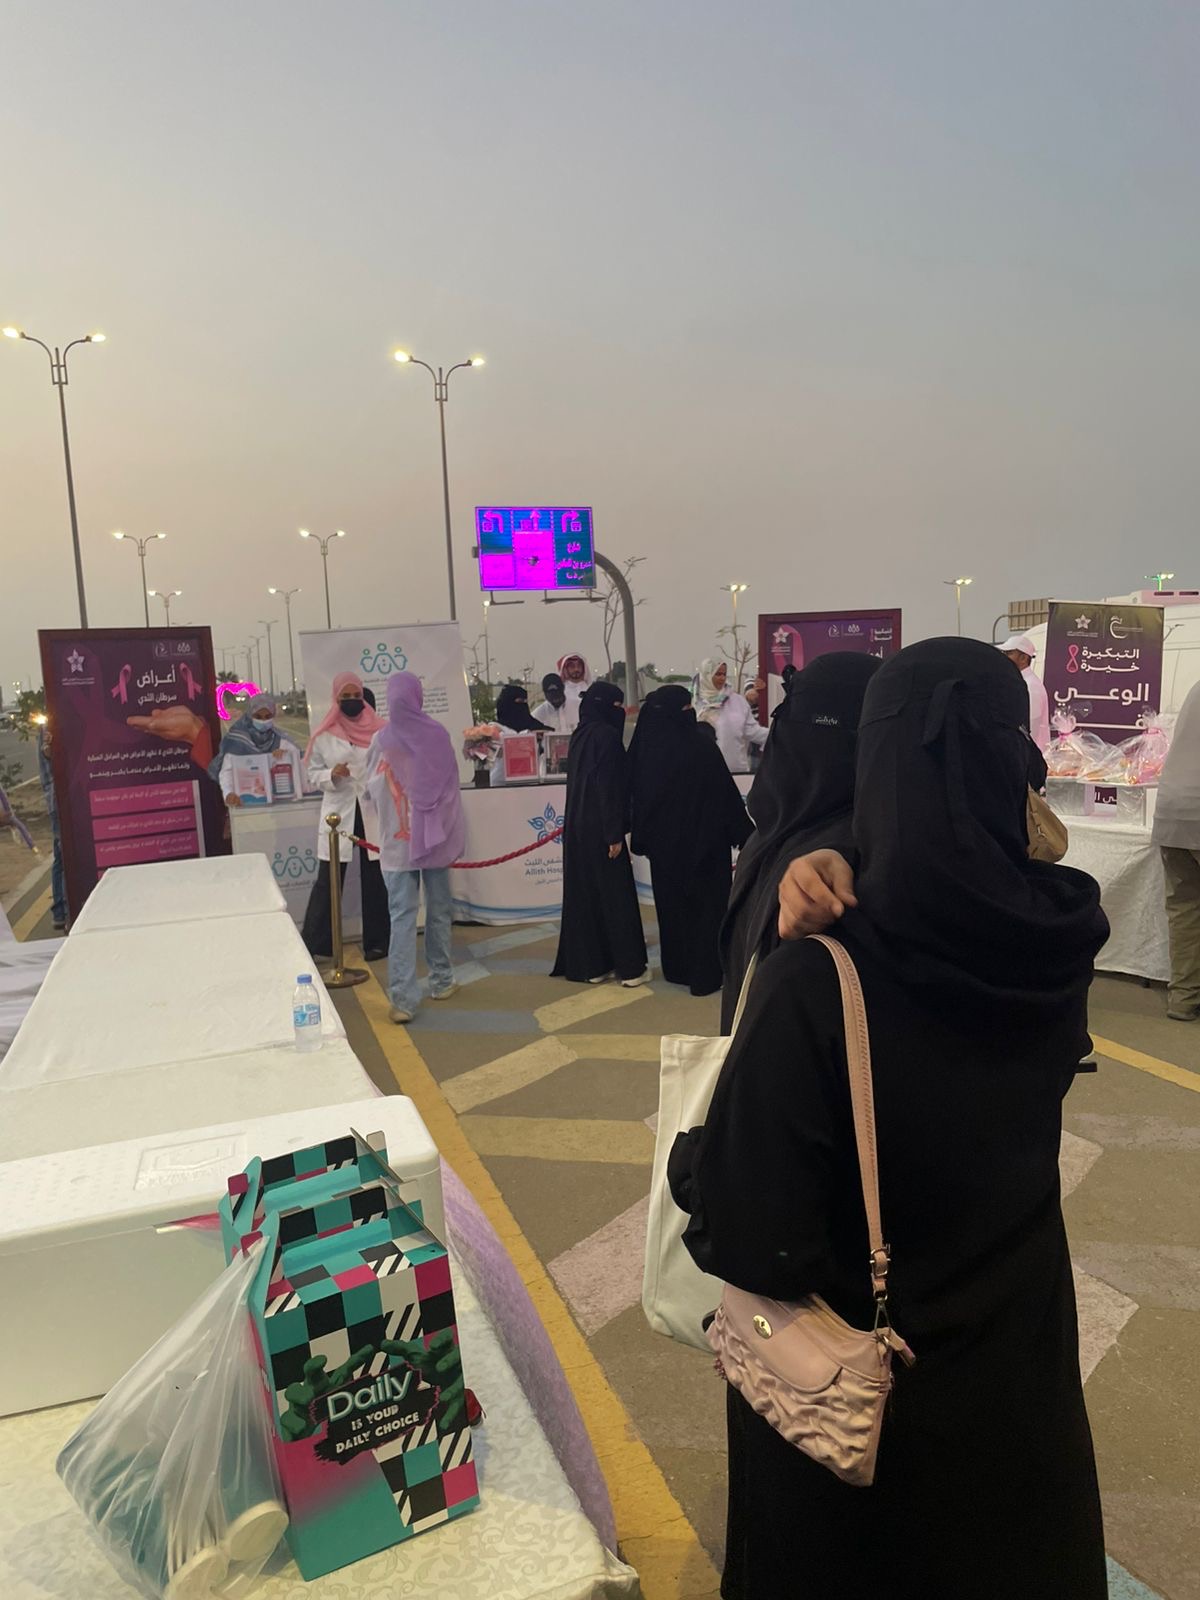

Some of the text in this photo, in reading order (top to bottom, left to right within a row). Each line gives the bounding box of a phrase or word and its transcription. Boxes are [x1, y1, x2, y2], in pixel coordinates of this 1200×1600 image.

[1081, 646, 1140, 661] التبكيرة
[1080, 659, 1140, 673] خيرة
[136, 664, 176, 688] أعراض
[137, 692, 177, 706] سرطان الثدي
[1054, 682, 1150, 707] الوعي
[327, 1371, 413, 1422] Daily
[335, 1411, 420, 1454] DAILY CHOICE
[351, 1418, 363, 1432] IS
